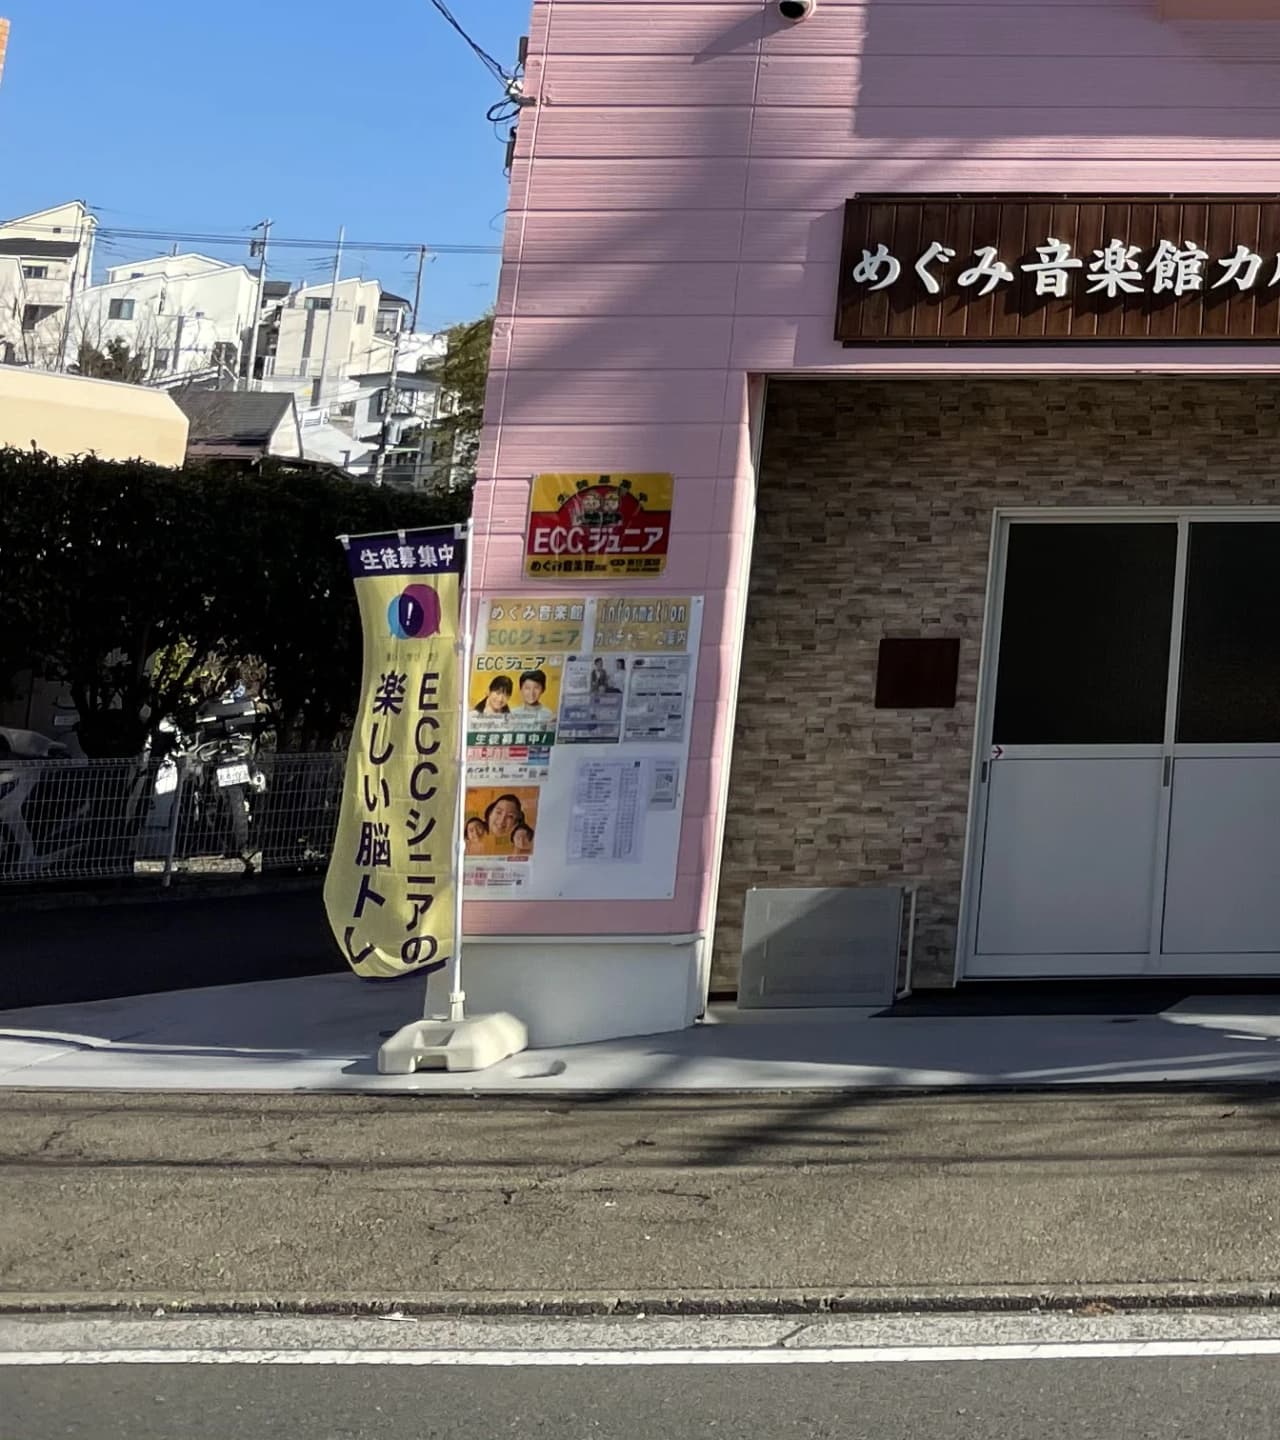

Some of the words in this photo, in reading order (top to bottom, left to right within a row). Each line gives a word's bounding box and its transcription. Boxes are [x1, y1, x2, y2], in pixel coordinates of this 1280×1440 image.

[533, 526, 664, 553] ECCジュニア
[360, 543, 455, 570] 生徒募集中
[490, 604, 585, 622] めぐみ音楽館
[487, 628, 581, 645] ECCジュニア
[475, 656, 546, 671] ECCジュニア
[343, 669, 408, 965] 楽しい脳トレ
[401, 671, 440, 965] ECCシニアの
